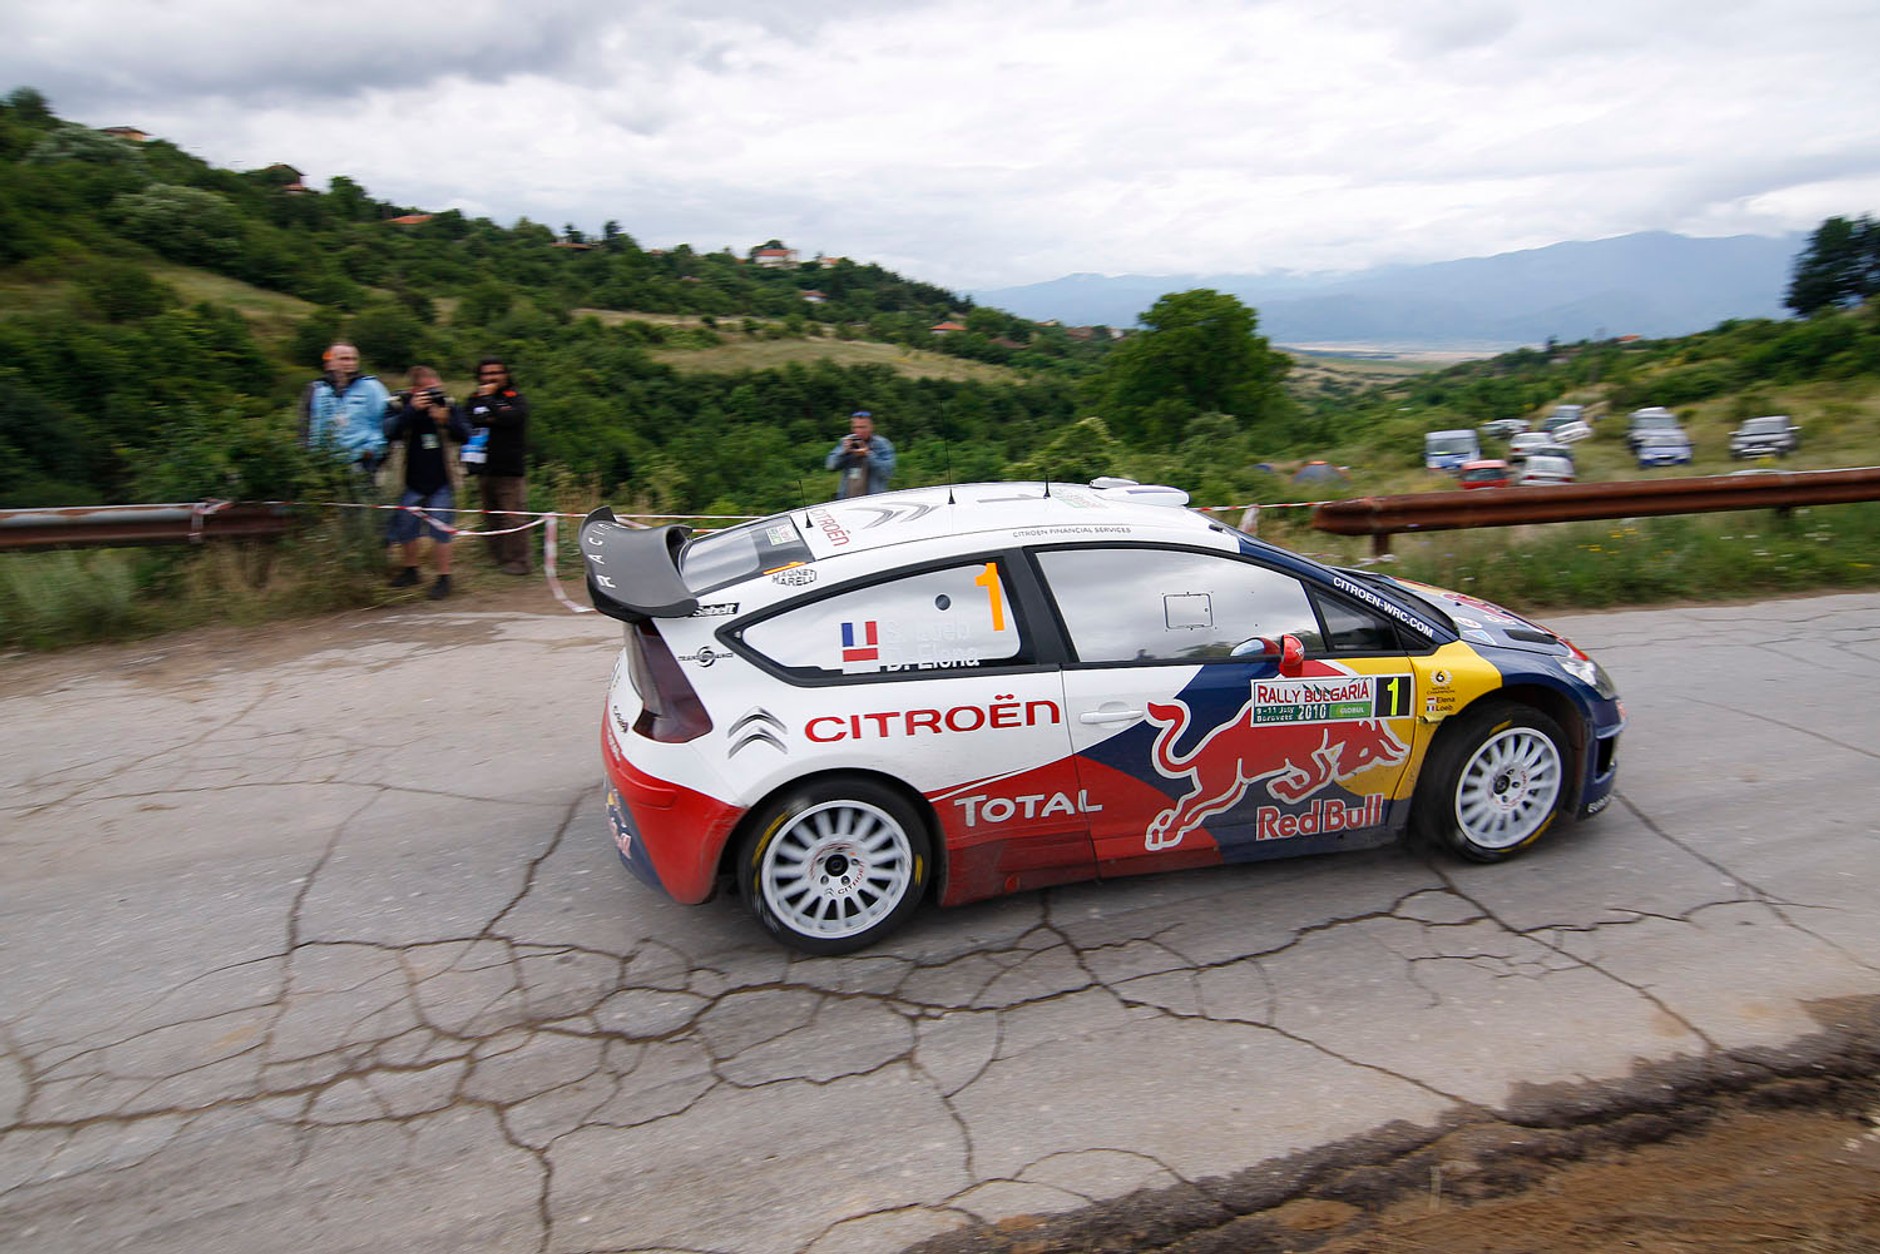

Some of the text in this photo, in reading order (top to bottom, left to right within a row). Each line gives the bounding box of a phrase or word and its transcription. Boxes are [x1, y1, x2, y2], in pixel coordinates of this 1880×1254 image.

[1050, 527, 1093, 535] FINANCIAL
[1095, 526, 1131, 534] SERVICES
[975, 562, 1005, 631] 1
[1333, 577, 1434, 638] CITROEN-WRC.COM
[1257, 681, 1369, 704] RALLY BULGARIA
[1436, 671, 1445, 682] 6
[1297, 704, 1326, 720] 2010
[1386, 677, 1399, 717] 1
[804, 694, 1061, 743] CITROËN
[954, 790, 1104, 828] TOTAL
[1256, 793, 1384, 841] Red Bull
